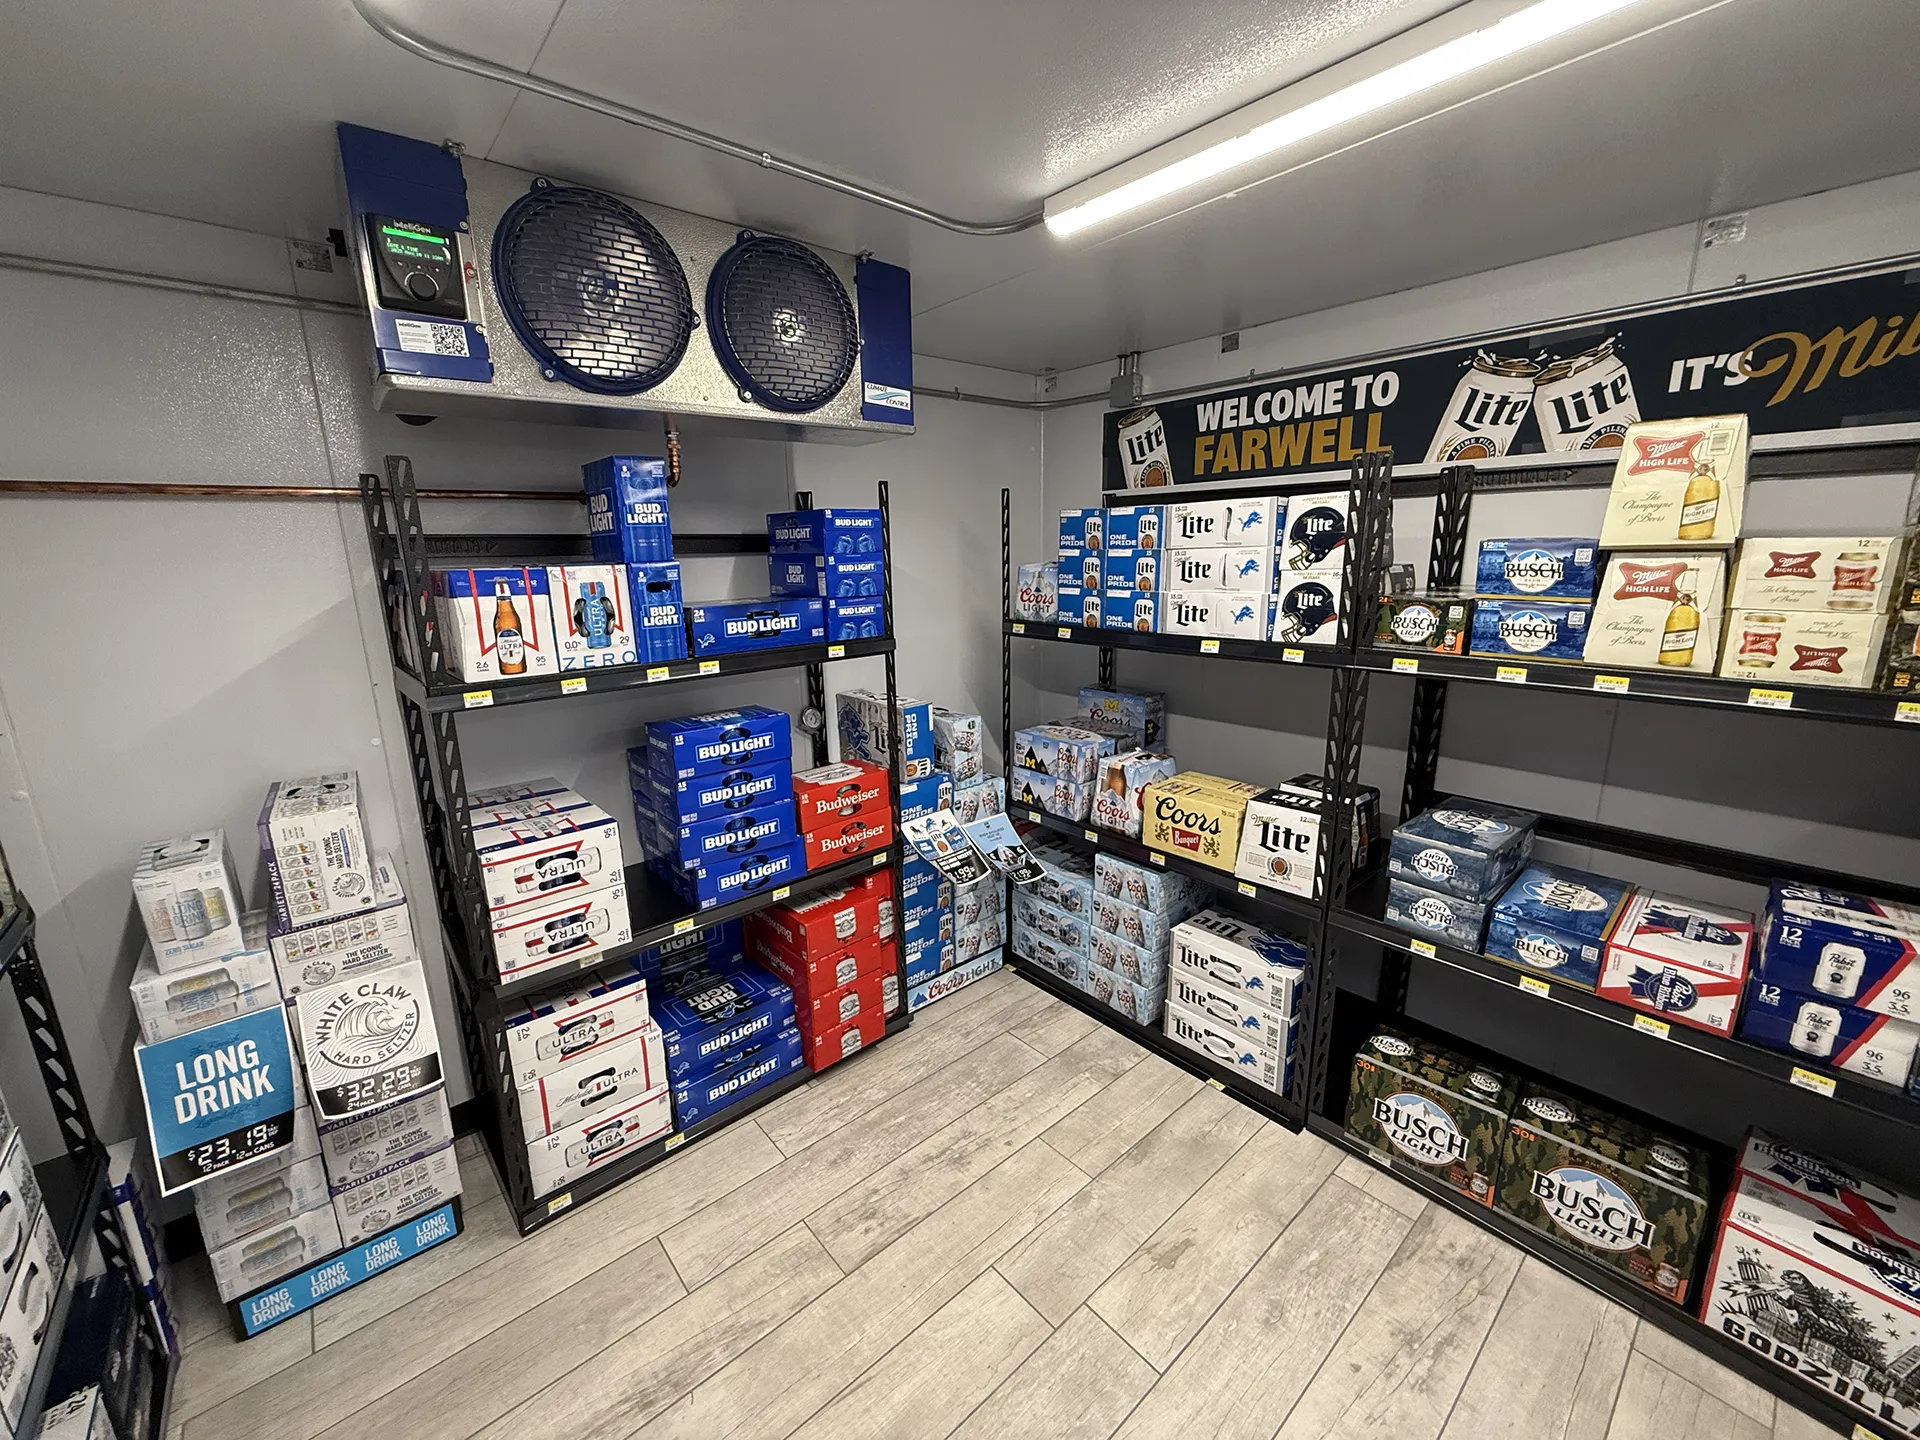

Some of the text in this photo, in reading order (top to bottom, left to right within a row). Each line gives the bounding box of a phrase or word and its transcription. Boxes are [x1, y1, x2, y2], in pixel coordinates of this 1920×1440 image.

[1668, 311, 1920, 407] IT'S Mil
[1197, 371, 1400, 432] WELCOME TO
[1454, 386, 1528, 432] Lite
[1550, 374, 1631, 434] Lite
[1194, 412, 1392, 476] FARWELL
[1647, 440, 1688, 458] Miller
[1640, 457, 1689, 467] HIGH LIFE
[1622, 500, 1673, 512] Champagne
[1641, 491, 1661, 501] The
[627, 512, 664, 524] LIGHT
[634, 503, 660, 514] BUD
[1181, 515, 1214, 539] Lite
[1306, 518, 1334, 535] Lite
[1626, 514, 1665, 526] of Beers
[838, 563, 874, 572] BUD LIGHT
[1180, 559, 1211, 583] Lite
[1506, 564, 1563, 580] BUSCH
[1632, 570, 1670, 584] Miller
[1020, 587, 1054, 604] Coors
[1297, 592, 1324, 610] Lite
[1776, 587, 1817, 596] Champagne
[644, 614, 679, 626] LIGHT
[650, 606, 676, 616] BUD
[856, 606, 875, 614] LIGHT
[1176, 602, 1209, 626] Lite
[1623, 615, 1644, 625] The
[727, 616, 798, 634] BUD LIGHT
[1392, 616, 1439, 631] BUSCH
[1500, 623, 1557, 641] BUSCH
[1606, 622, 1655, 635] Champagne
[620, 636, 630, 644] 29
[1610, 635, 1646, 646] of Beers
[562, 650, 636, 670] ZERO
[1104, 699, 1119, 712] M
[698, 736, 772, 759] BUD LIGHT
[1058, 747, 1077, 764] Coor
[702, 779, 774, 804] BUD LIGHT
[816, 788, 879, 814] Budweiser
[1156, 796, 1221, 834] Coors
[604, 828, 613, 839] 95
[705, 822, 777, 850] BUD LIGHT
[821, 825, 885, 852] Budweiser
[1174, 829, 1199, 846] Banquet
[1258, 821, 1311, 854] Lite
[538, 859, 586, 880] ULTRA
[720, 858, 788, 888] BUD LIGHT
[268, 861, 287, 922] VARIETY 24 PACK
[613, 888, 620, 900] 95
[548, 921, 595, 942] ULTRA
[618, 930, 626, 942] 2.6
[1781, 926, 1802, 941] 12
[164, 941, 204, 956] ZERO SUGAR
[342, 948, 389, 966] HARD SELTZER
[346, 944, 383, 958] THE ICONIC
[1179, 946, 1209, 969] Lite
[1515, 940, 1567, 962] BUSCH
[1828, 953, 1856, 967] Pabst
[1830, 962, 1851, 971] Light
[928, 958, 996, 999] Coors LIGHT
[1655, 968, 1676, 1009] Blue Ribbon
[1178, 981, 1206, 1006] Lite
[1760, 984, 1781, 997] 12
[1892, 988, 1911, 1000] 96
[316, 982, 411, 1046] WHITE CLAW
[1806, 1012, 1833, 1026] Pabst
[333, 1012, 415, 1064] HARD SELTZER
[552, 1026, 596, 1048] ULTRA
[701, 1016, 770, 1055] BUD LIGHT
[1175, 1017, 1202, 1043] Lite
[669, 1044, 679, 1052] 24
[1866, 1050, 1883, 1061] 96
[176, 1040, 260, 1091] LONG
[1357, 1060, 1370, 1070] 30
[556, 1068, 638, 1107] Michelob ULTRA
[709, 1058, 778, 1100] BUD LIGHT
[174, 1064, 275, 1124] DRINK
[389, 1127, 422, 1146] THE ICONIC
[1372, 1098, 1469, 1161] BUSCH
[254, 1142, 275, 1154] CANS
[580, 1131, 622, 1155] ULTRA
[1390, 1130, 1444, 1160] LIGHT
[339, 1158, 411, 1192] VARIETY 24 PACK
[1531, 1171, 1655, 1249] BUSCH
[415, 1213, 446, 1236] LONG
[416, 1223, 450, 1247] DRINK
[1554, 1207, 1622, 1245] LIGHT
[365, 1236, 398, 1261] LONG
[365, 1246, 402, 1272] DRINK
[311, 1261, 345, 1286] LONG
[310, 1272, 351, 1299] DRINK
[251, 1288, 290, 1313] LONG
[252, 1298, 295, 1326] DRINK
[1723, 1316, 1920, 1437] GODZILL
